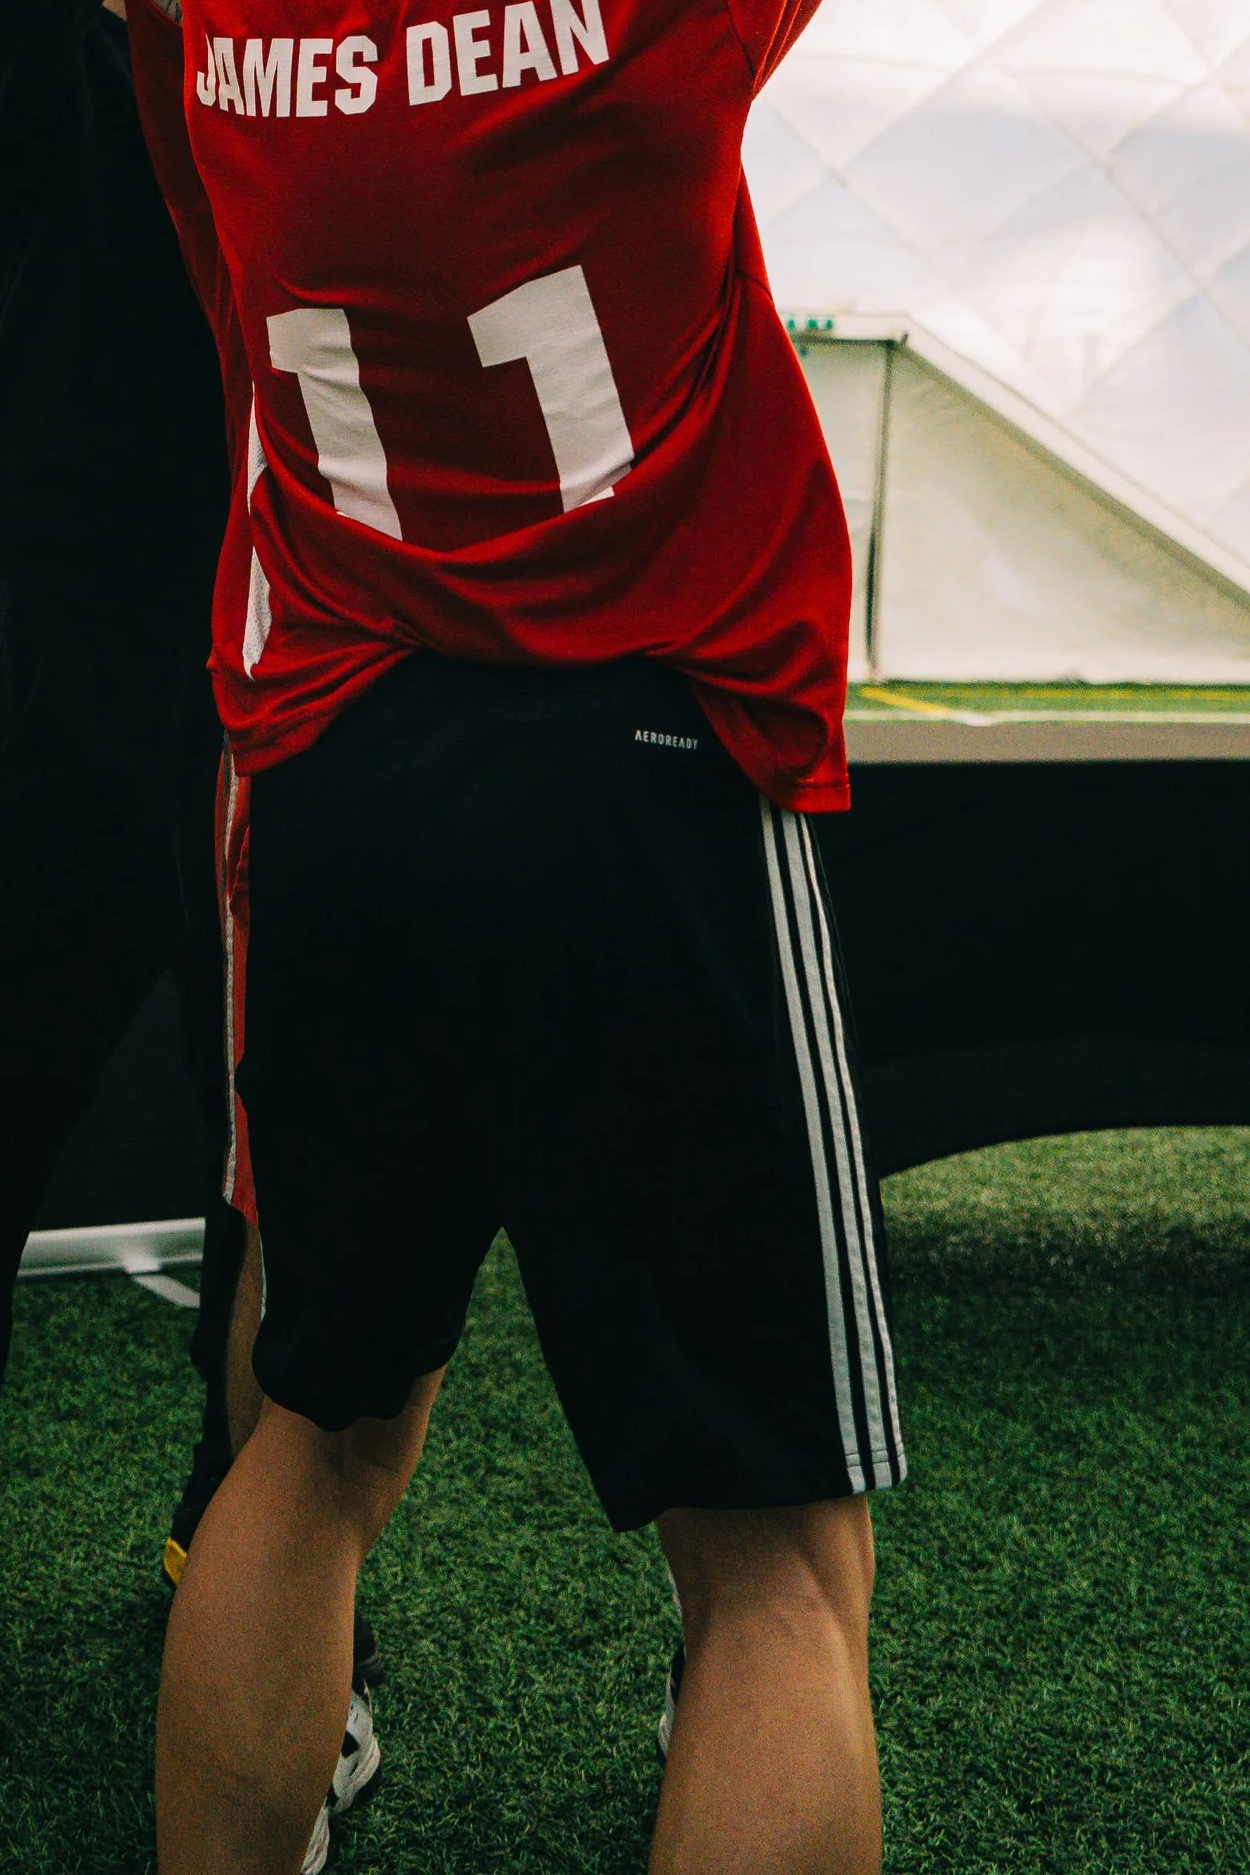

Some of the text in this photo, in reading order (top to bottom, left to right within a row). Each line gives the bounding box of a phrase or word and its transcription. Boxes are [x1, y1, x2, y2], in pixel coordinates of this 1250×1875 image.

[196, 34, 378, 118] JAMES
[266, 265, 635, 540] 11
[634, 729, 698, 750] AEROREADY
